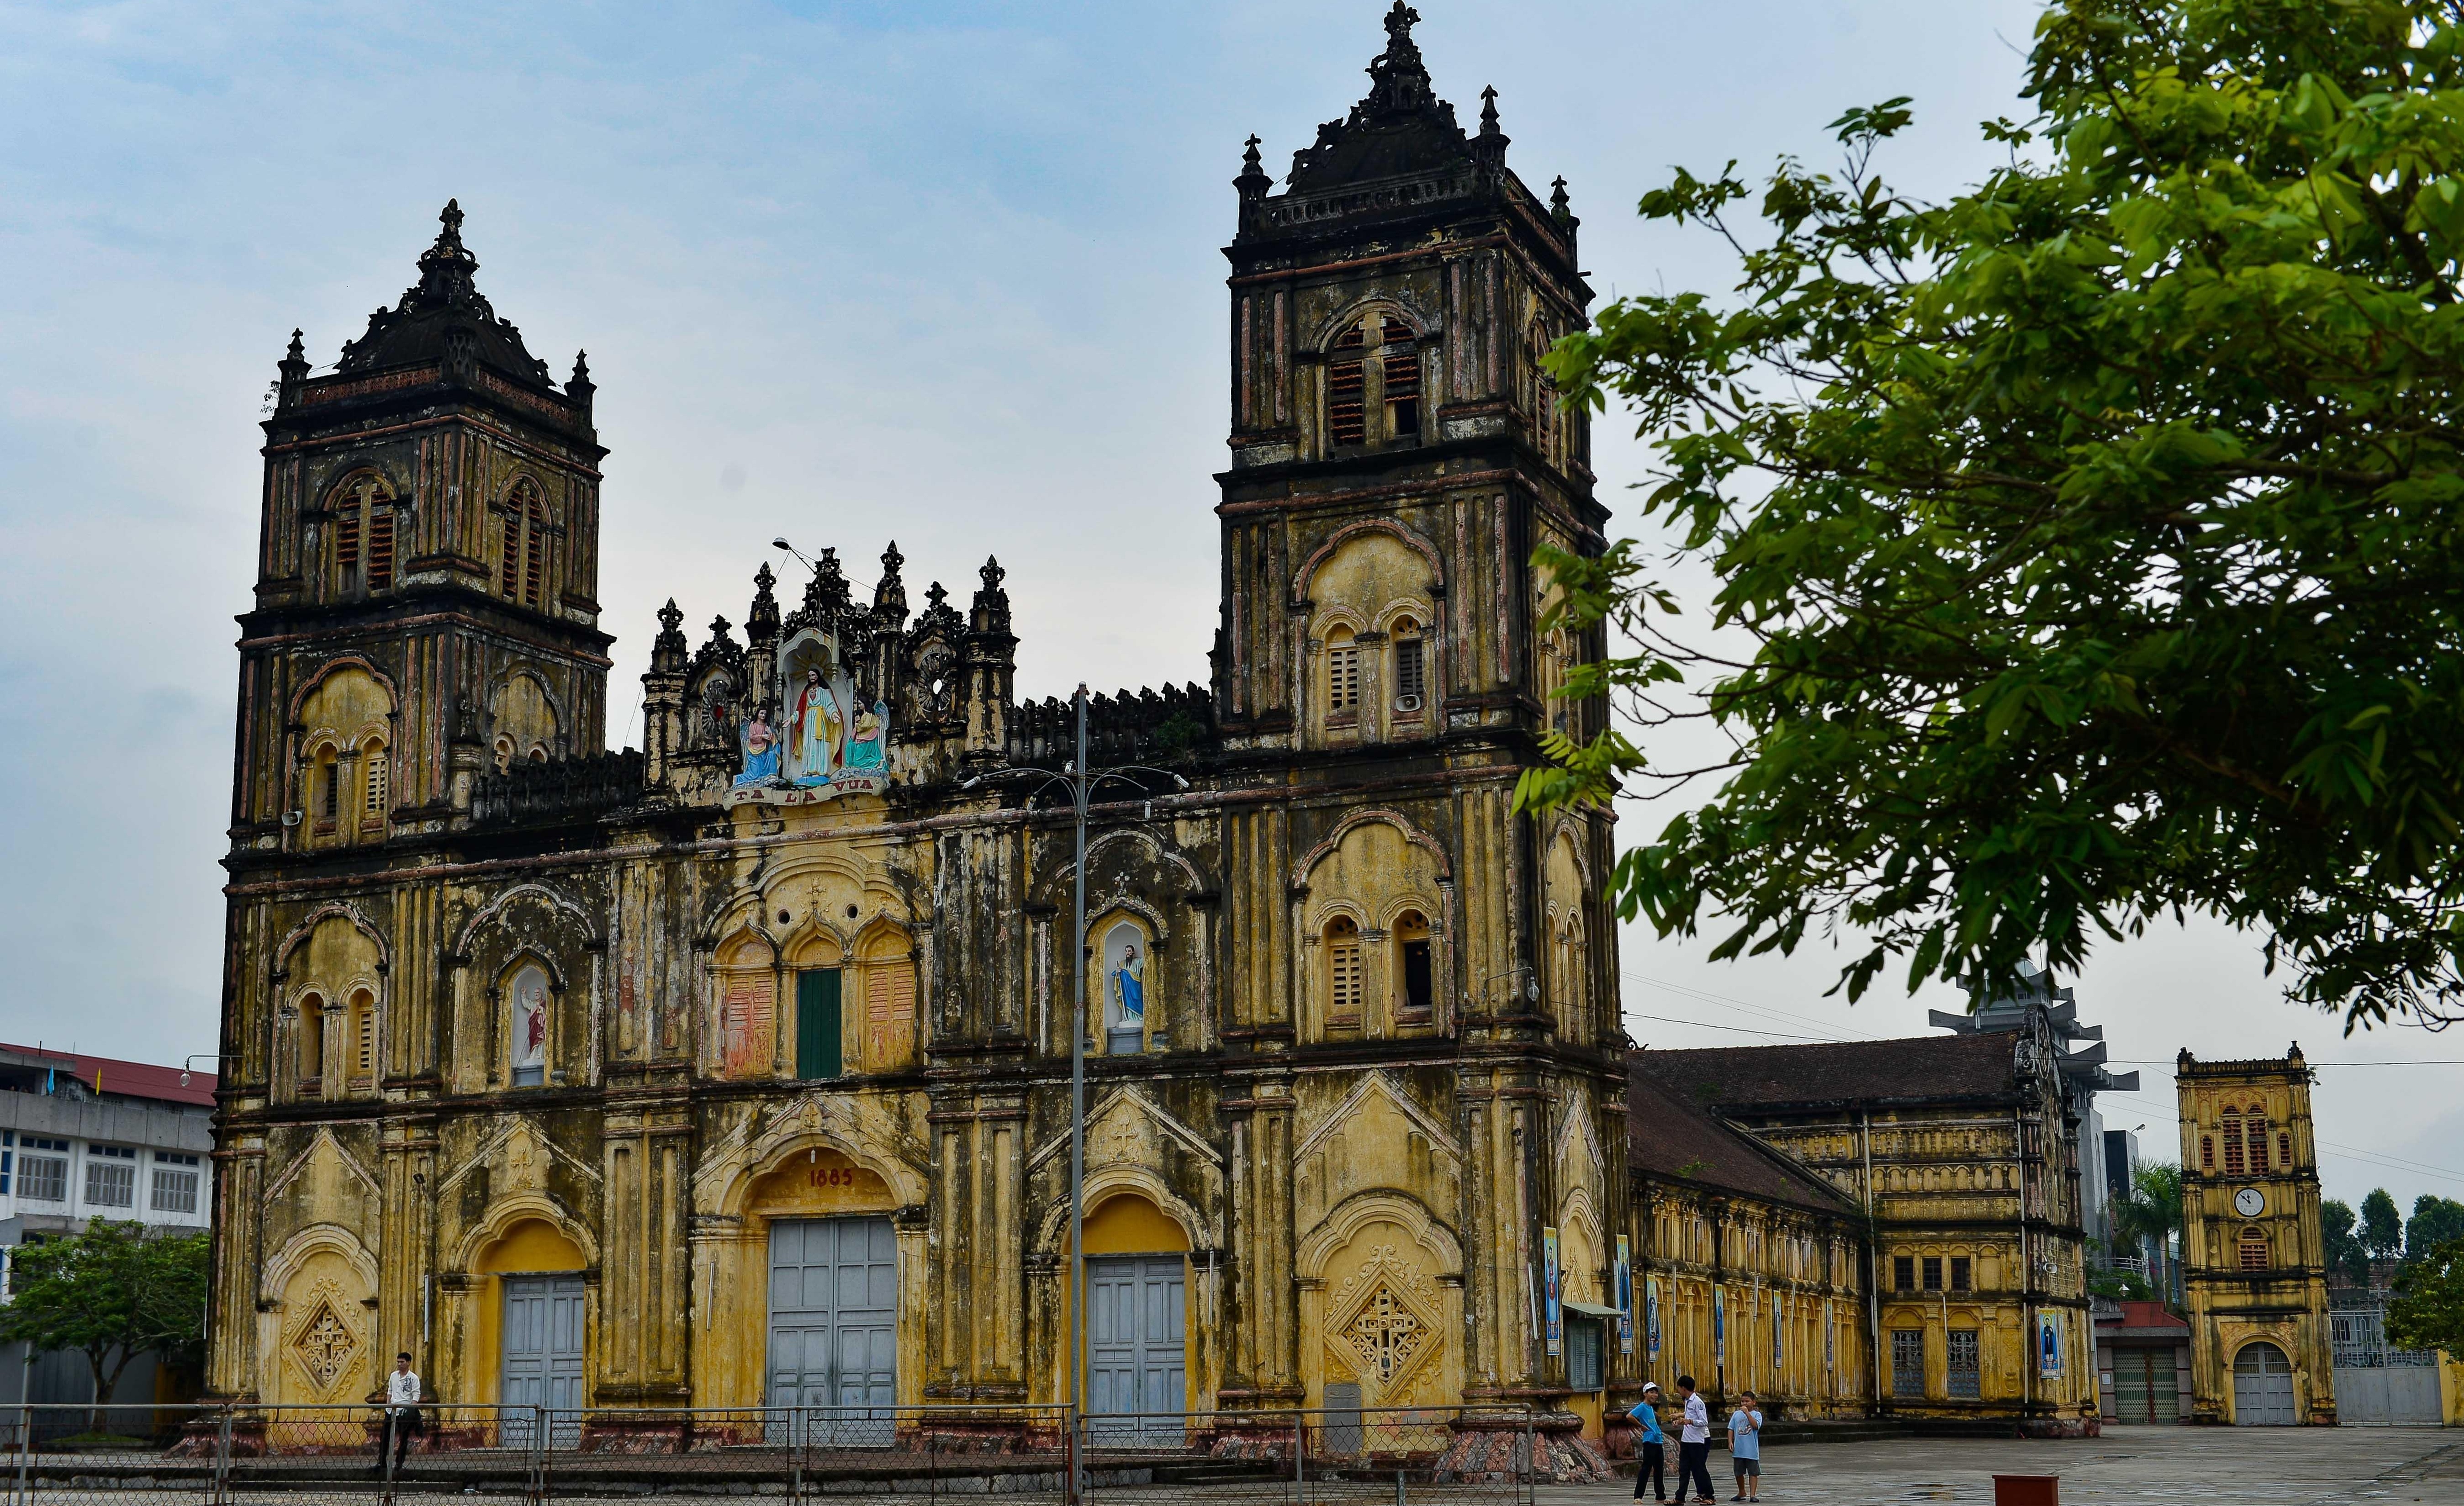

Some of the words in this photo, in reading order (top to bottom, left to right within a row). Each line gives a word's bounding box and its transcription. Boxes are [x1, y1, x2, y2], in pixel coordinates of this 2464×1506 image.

[735, 789, 765, 801] TA
[785, 792, 817, 803] LA
[832, 779, 873, 792] VUA
[810, 1168, 852, 1188] 1885
